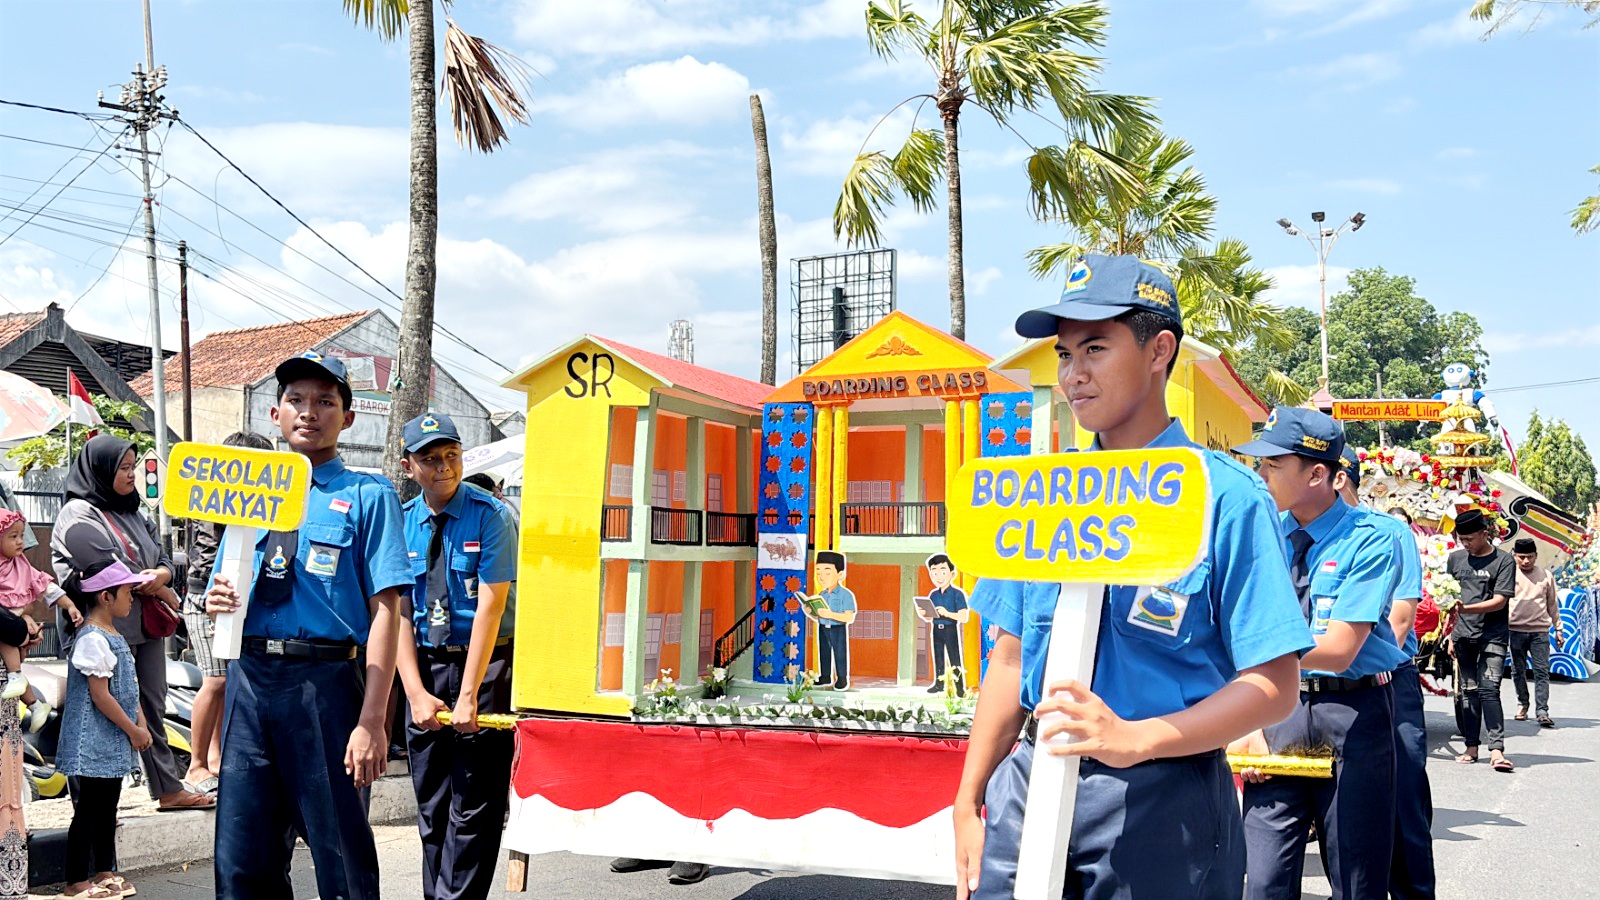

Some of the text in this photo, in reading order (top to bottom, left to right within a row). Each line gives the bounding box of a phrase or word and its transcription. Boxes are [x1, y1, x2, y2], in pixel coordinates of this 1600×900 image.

[564, 351, 615, 399] SR
[803, 371, 986, 396] BOARDING CLASS
[1340, 404, 1381, 417] Mantan
[1416, 404, 1440, 418] Lilin
[178, 456, 294, 492] SEKOLAH
[971, 461, 1185, 508] BOARDING
[188, 485, 284, 523] RAKYAT
[995, 515, 1136, 563] CLASS
